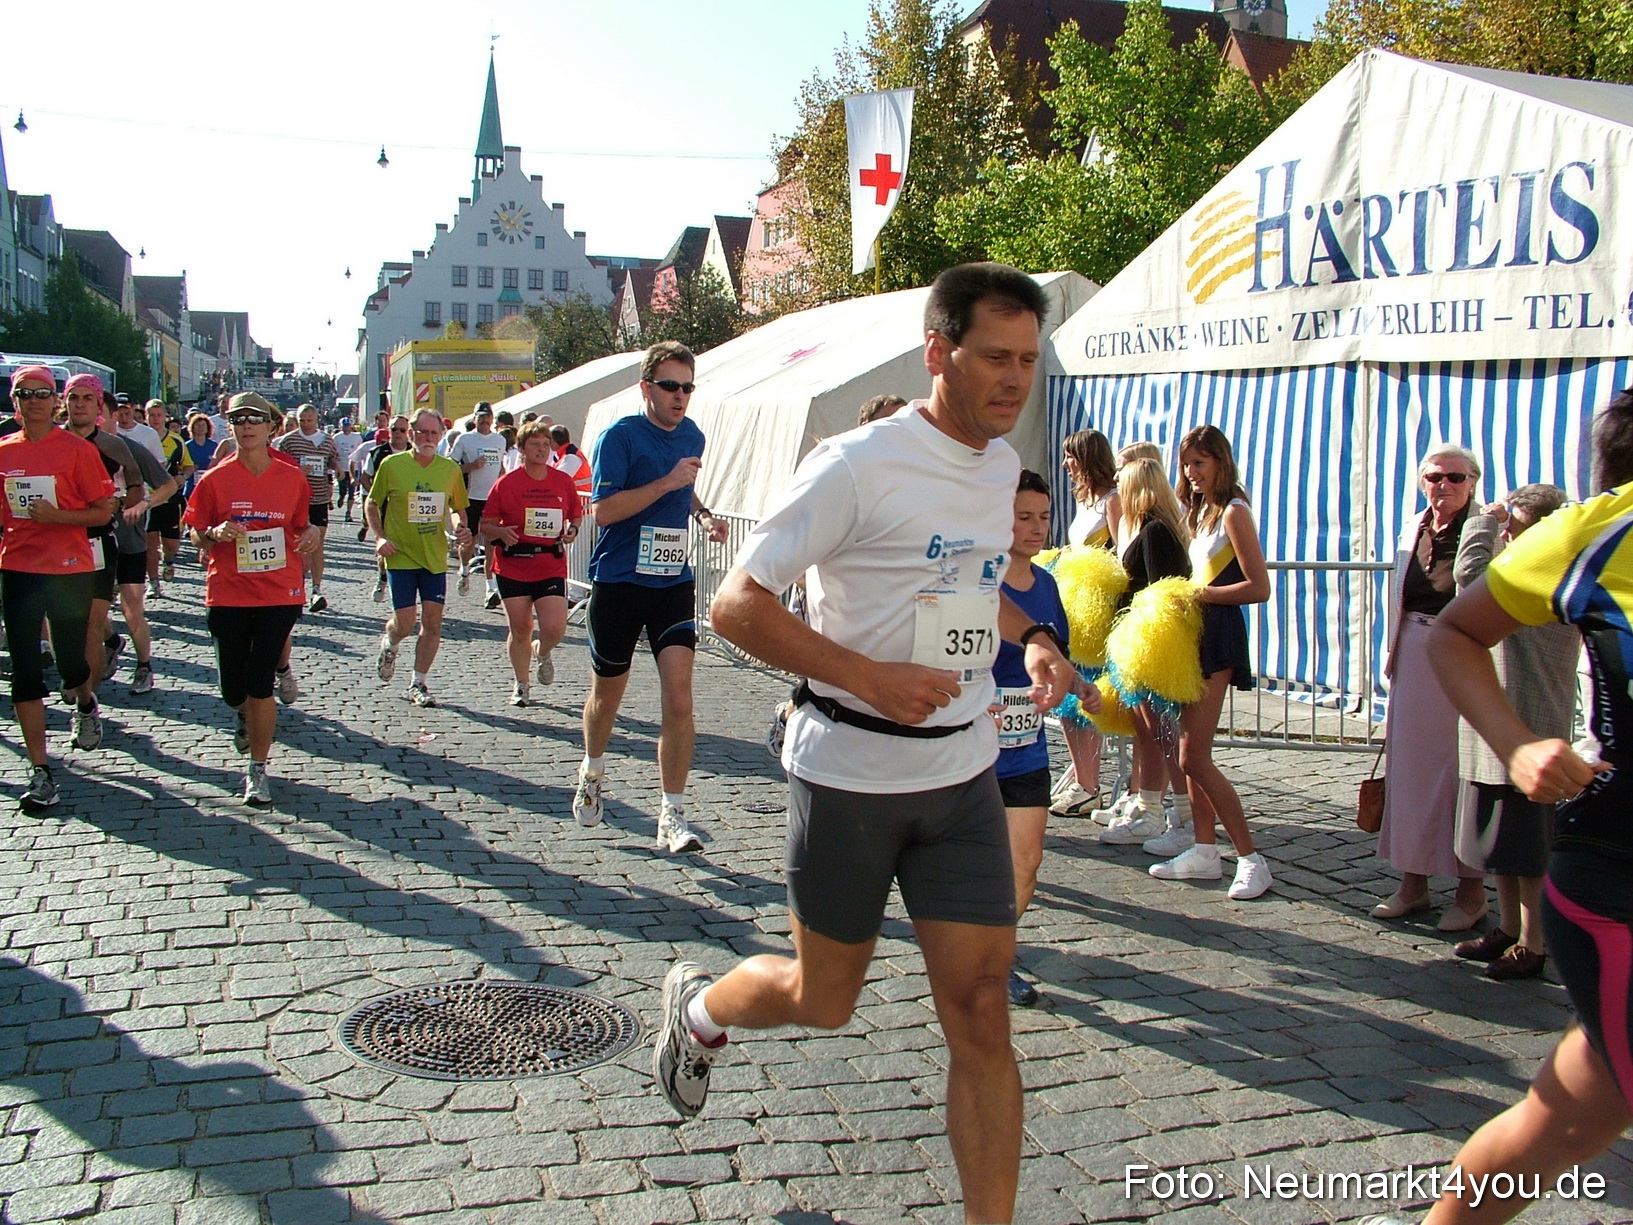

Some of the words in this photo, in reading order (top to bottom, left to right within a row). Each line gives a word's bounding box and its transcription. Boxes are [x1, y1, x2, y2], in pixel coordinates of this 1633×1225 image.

[1247, 157, 1600, 294] HÄRTEIS
[1085, 322, 1189, 359] GETRÄNKE
[1201, 315, 1270, 348] WEINE
[1523, 292, 1615, 330] TEL.
[418, 505, 437, 515] 328
[535, 521, 554, 530] 284
[248, 534, 272, 544] Carola
[654, 532, 681, 543] Michael
[239, 547, 246, 555] D
[251, 547, 276, 561] 165
[642, 543, 649, 552] D
[653, 548, 684, 563] 2962
[926, 534, 948, 560] 6.
[945, 627, 993, 656] 3571
[1003, 694, 1035, 707] Hildeg
[1003, 713, 1039, 732] 3352
